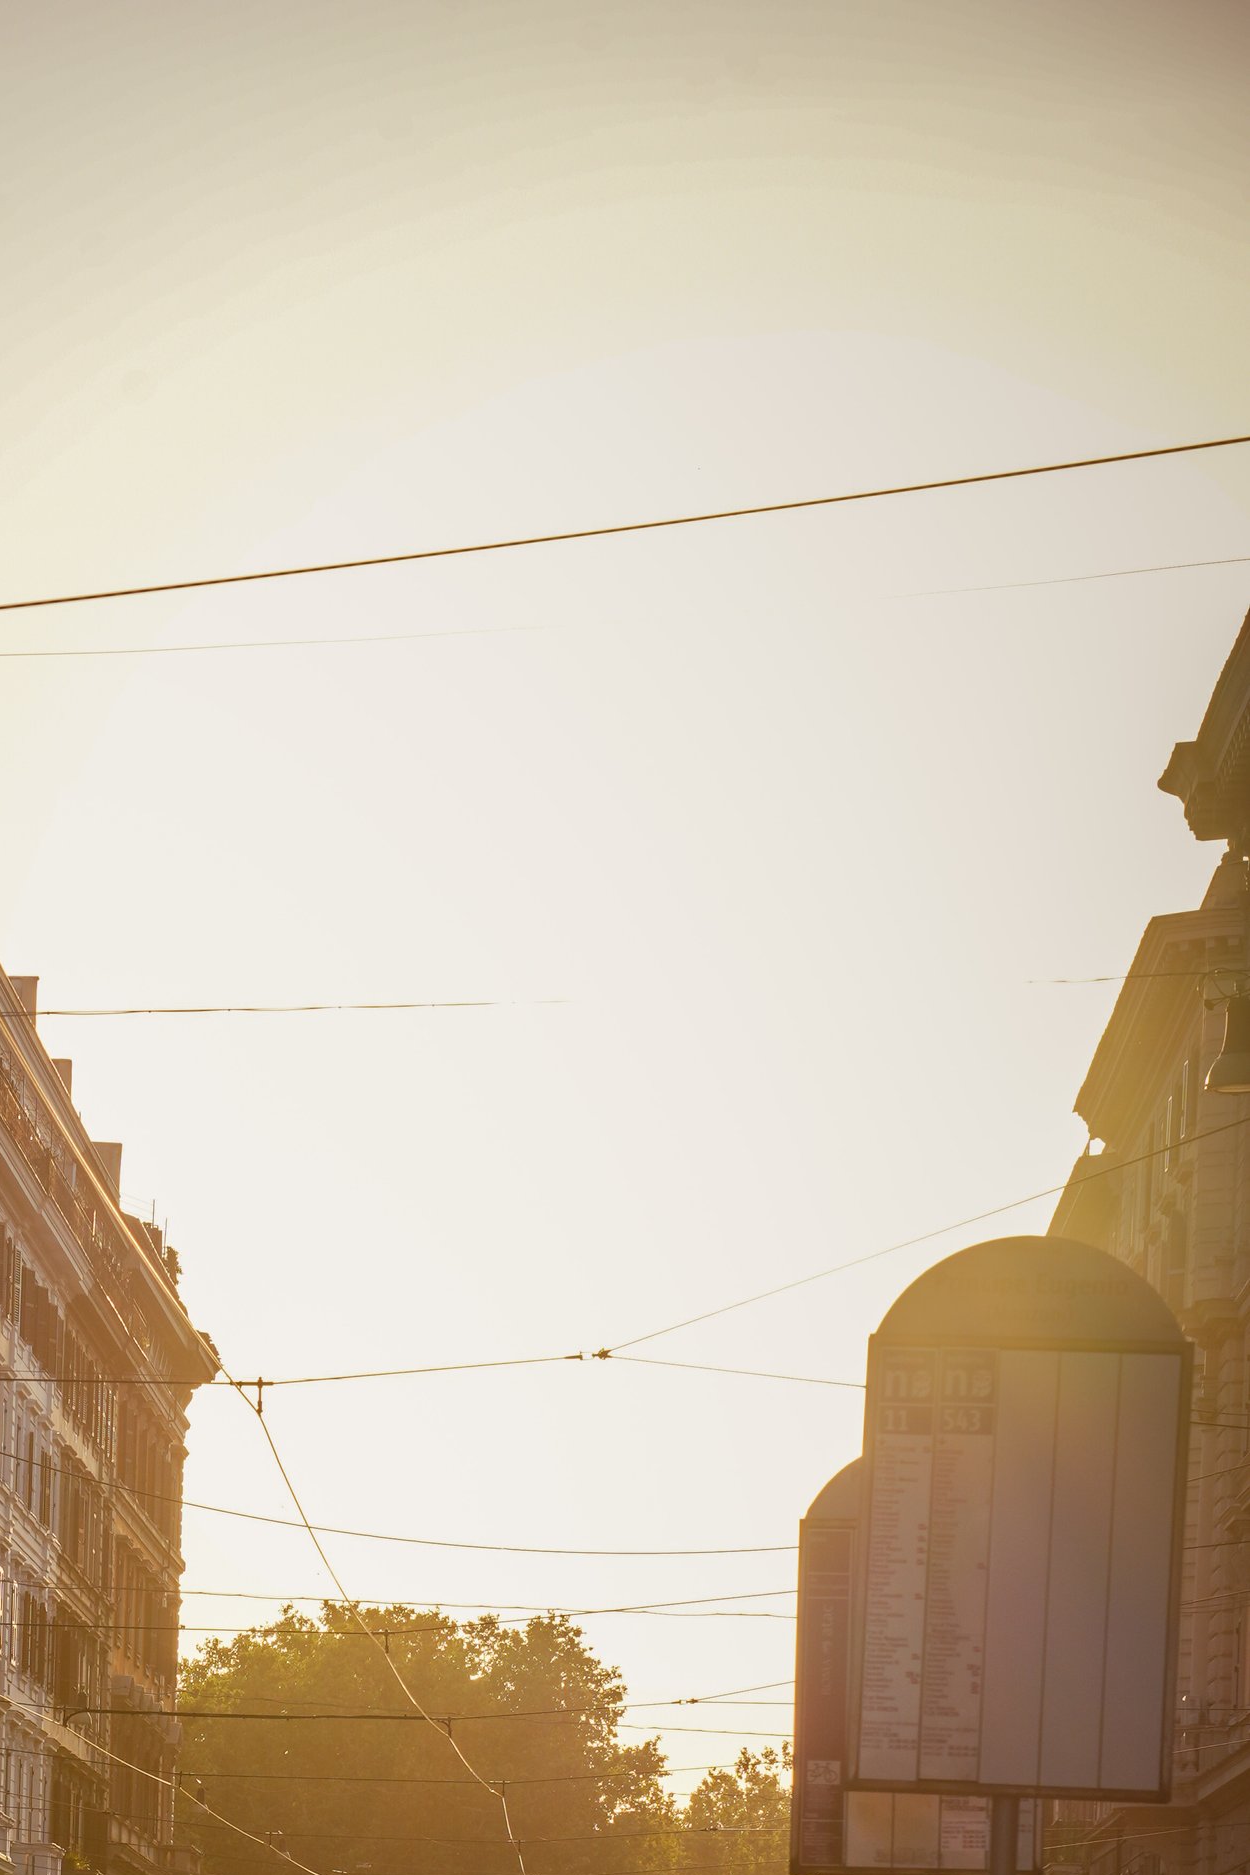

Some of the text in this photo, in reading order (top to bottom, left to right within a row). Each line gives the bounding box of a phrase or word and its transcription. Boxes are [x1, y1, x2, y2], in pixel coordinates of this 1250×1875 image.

[1036, 1271, 1129, 1300] Eugenio
[885, 1410, 908, 1431] 11
[943, 1410, 980, 1431] 543
